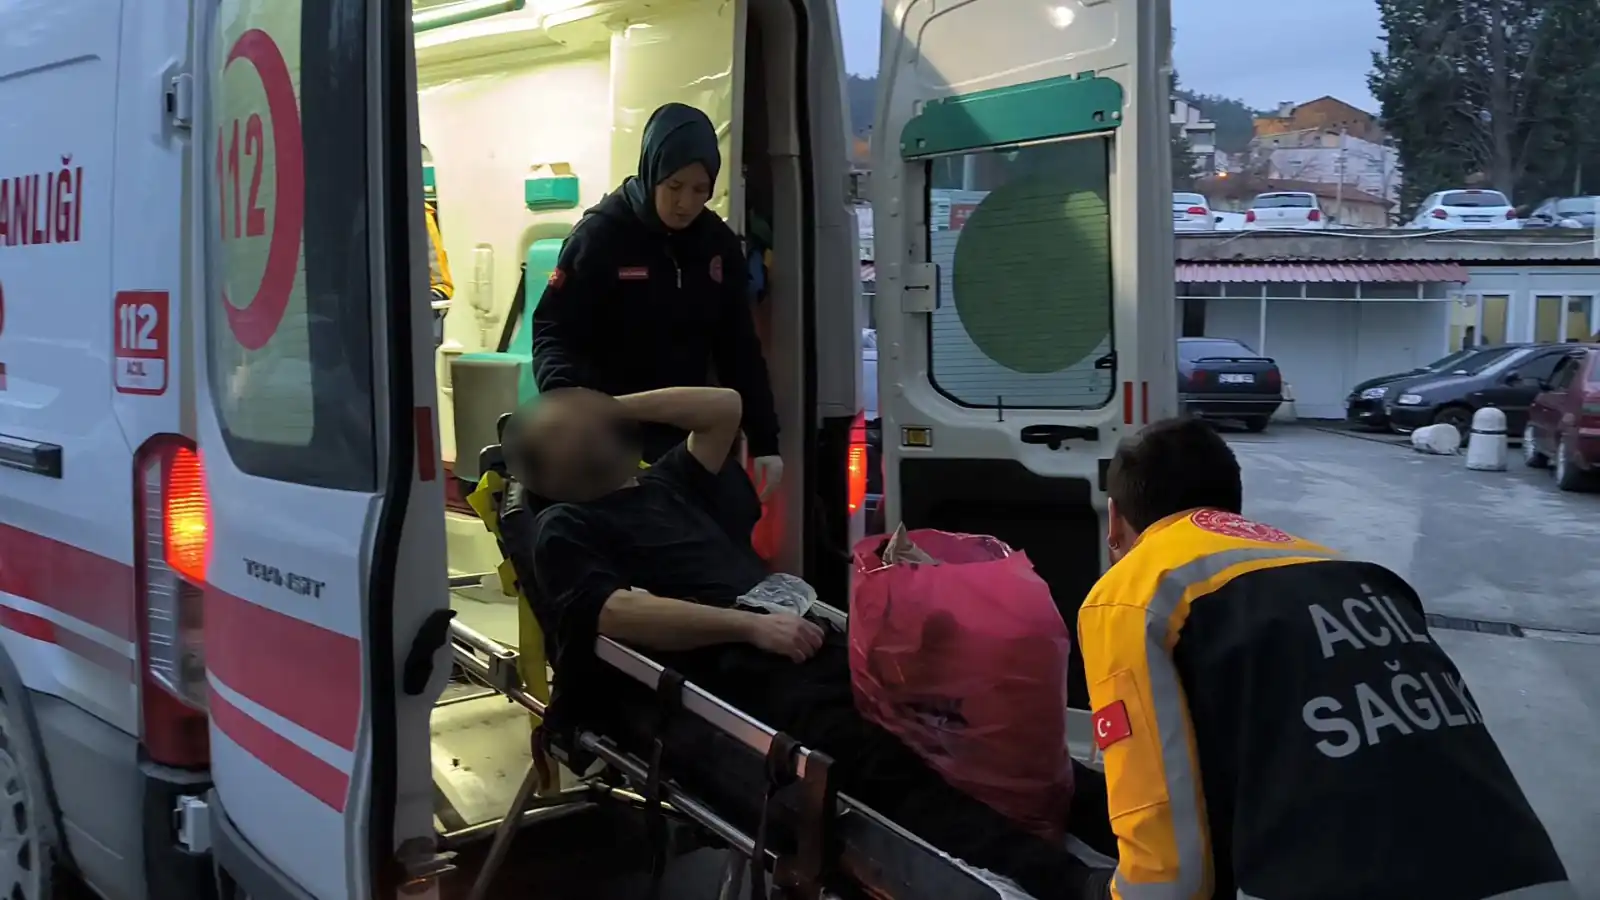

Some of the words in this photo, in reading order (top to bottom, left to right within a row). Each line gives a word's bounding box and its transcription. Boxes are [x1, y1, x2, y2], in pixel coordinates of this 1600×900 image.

[215, 112, 267, 242] 112
[119, 303, 159, 350] 112
[1308, 583, 1430, 659] ACİL
